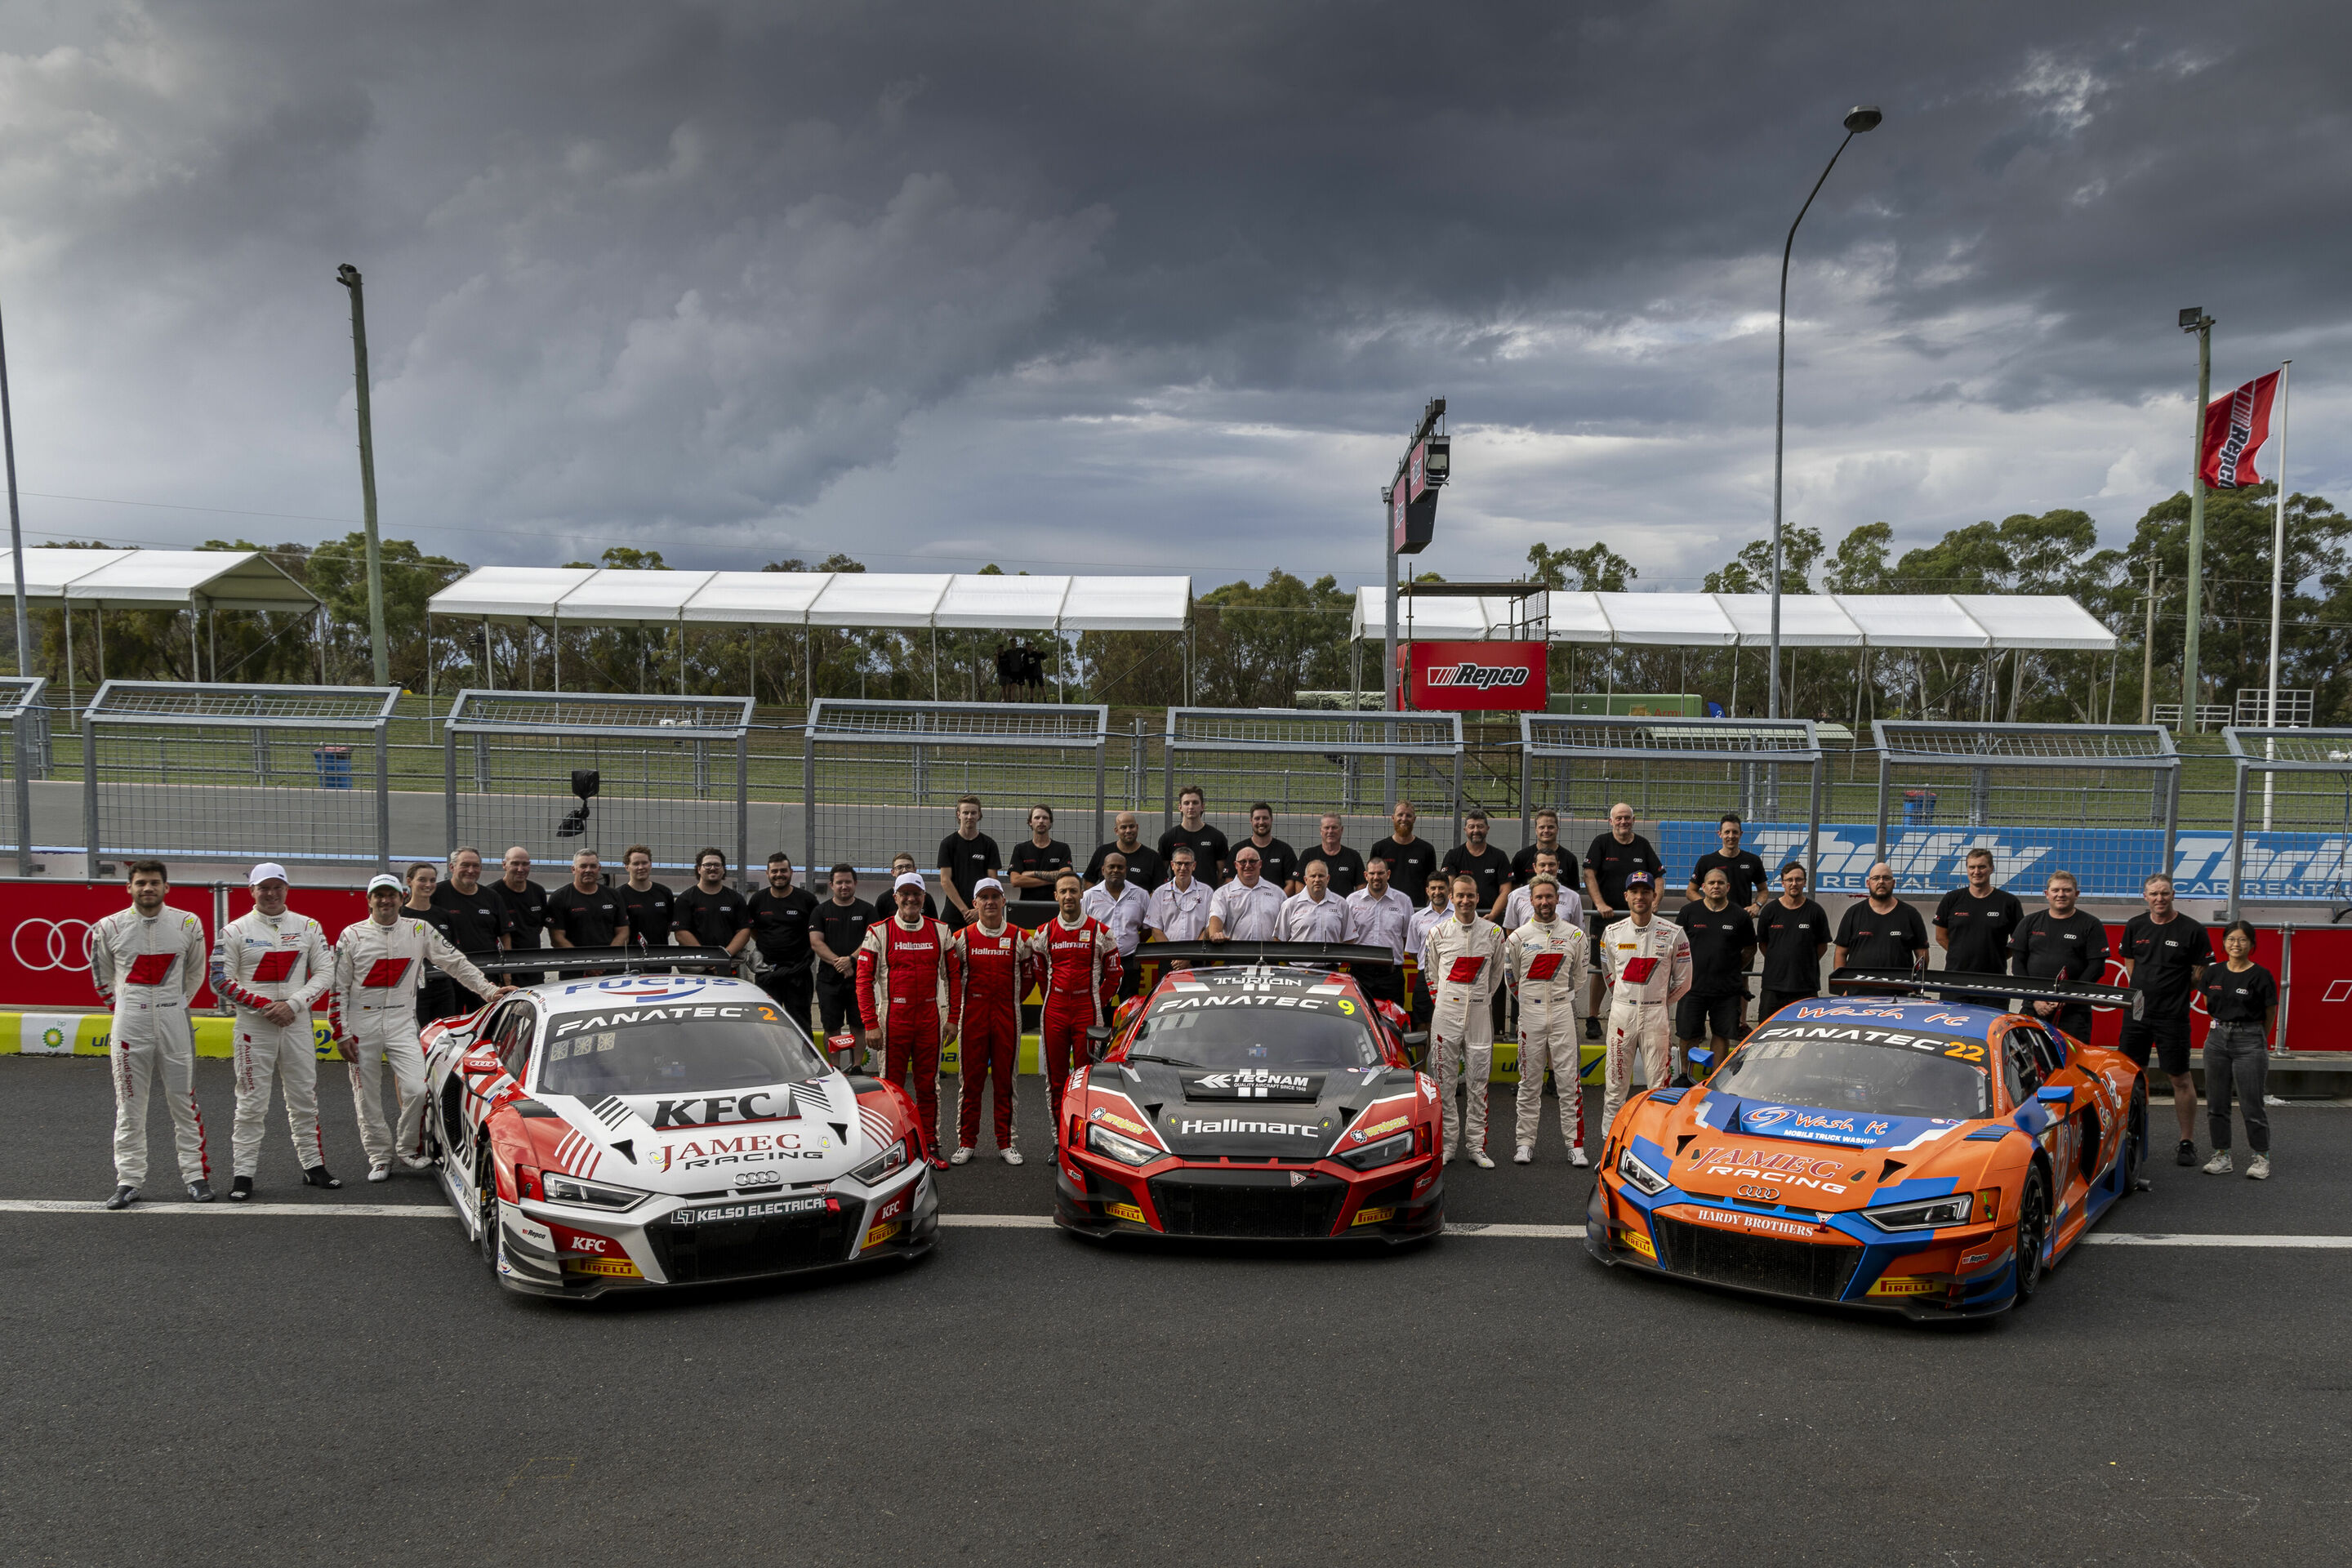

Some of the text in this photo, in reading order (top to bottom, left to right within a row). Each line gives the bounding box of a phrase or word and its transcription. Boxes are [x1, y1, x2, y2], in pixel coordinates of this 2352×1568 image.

[1453, 663, 1530, 690] Repco
[1750, 830, 2054, 890] Thrifty
[2172, 882, 2230, 894] CAR
[894, 942, 934, 951] Hallmarc
[1052, 941, 1090, 950] Hallmarc
[565, 977, 739, 996] FUCHS
[1156, 995, 1356, 1016] FANATEC 9
[555, 1006, 742, 1037] FANATEC
[757, 1006, 778, 1021] 2
[1797, 1005, 1971, 1027] Wash It
[1757, 1027, 1985, 1062] FANATEC 22
[122, 1074, 135, 1098] Sport
[246, 1066, 256, 1091] Sport
[1232, 1074, 1309, 1087] TECNAM
[651, 1092, 777, 1128] KFC
[1181, 1119, 1319, 1138] Hallmarc
[1796, 1112, 1889, 1135] Wash It
[1784, 1129, 1814, 1138] MOBILE
[1815, 1133, 1842, 1142] TRUCK
[660, 1134, 801, 1174] JAMEC
[684, 1151, 823, 1170] RACING
[1687, 1147, 1844, 1179] JAMEC
[1706, 1165, 1847, 1195] RACING
[697, 1206, 746, 1222] KELSO
[881, 1200, 901, 1220] KFC
[1107, 1202, 1140, 1220] PIRELLI
[1358, 1207, 1392, 1224] PIRELLI
[1698, 1209, 1814, 1237] HARDY BROTHERS
[527, 1229, 546, 1240] Repco
[868, 1226, 898, 1244] PIRELLI
[1625, 1230, 1650, 1252] PIRELLI
[571, 1236, 607, 1253] KFC
[580, 1258, 633, 1275] PIRELLI
[1969, 1253, 1989, 1263] Repco
[1880, 1280, 1934, 1293] PIRELLI
